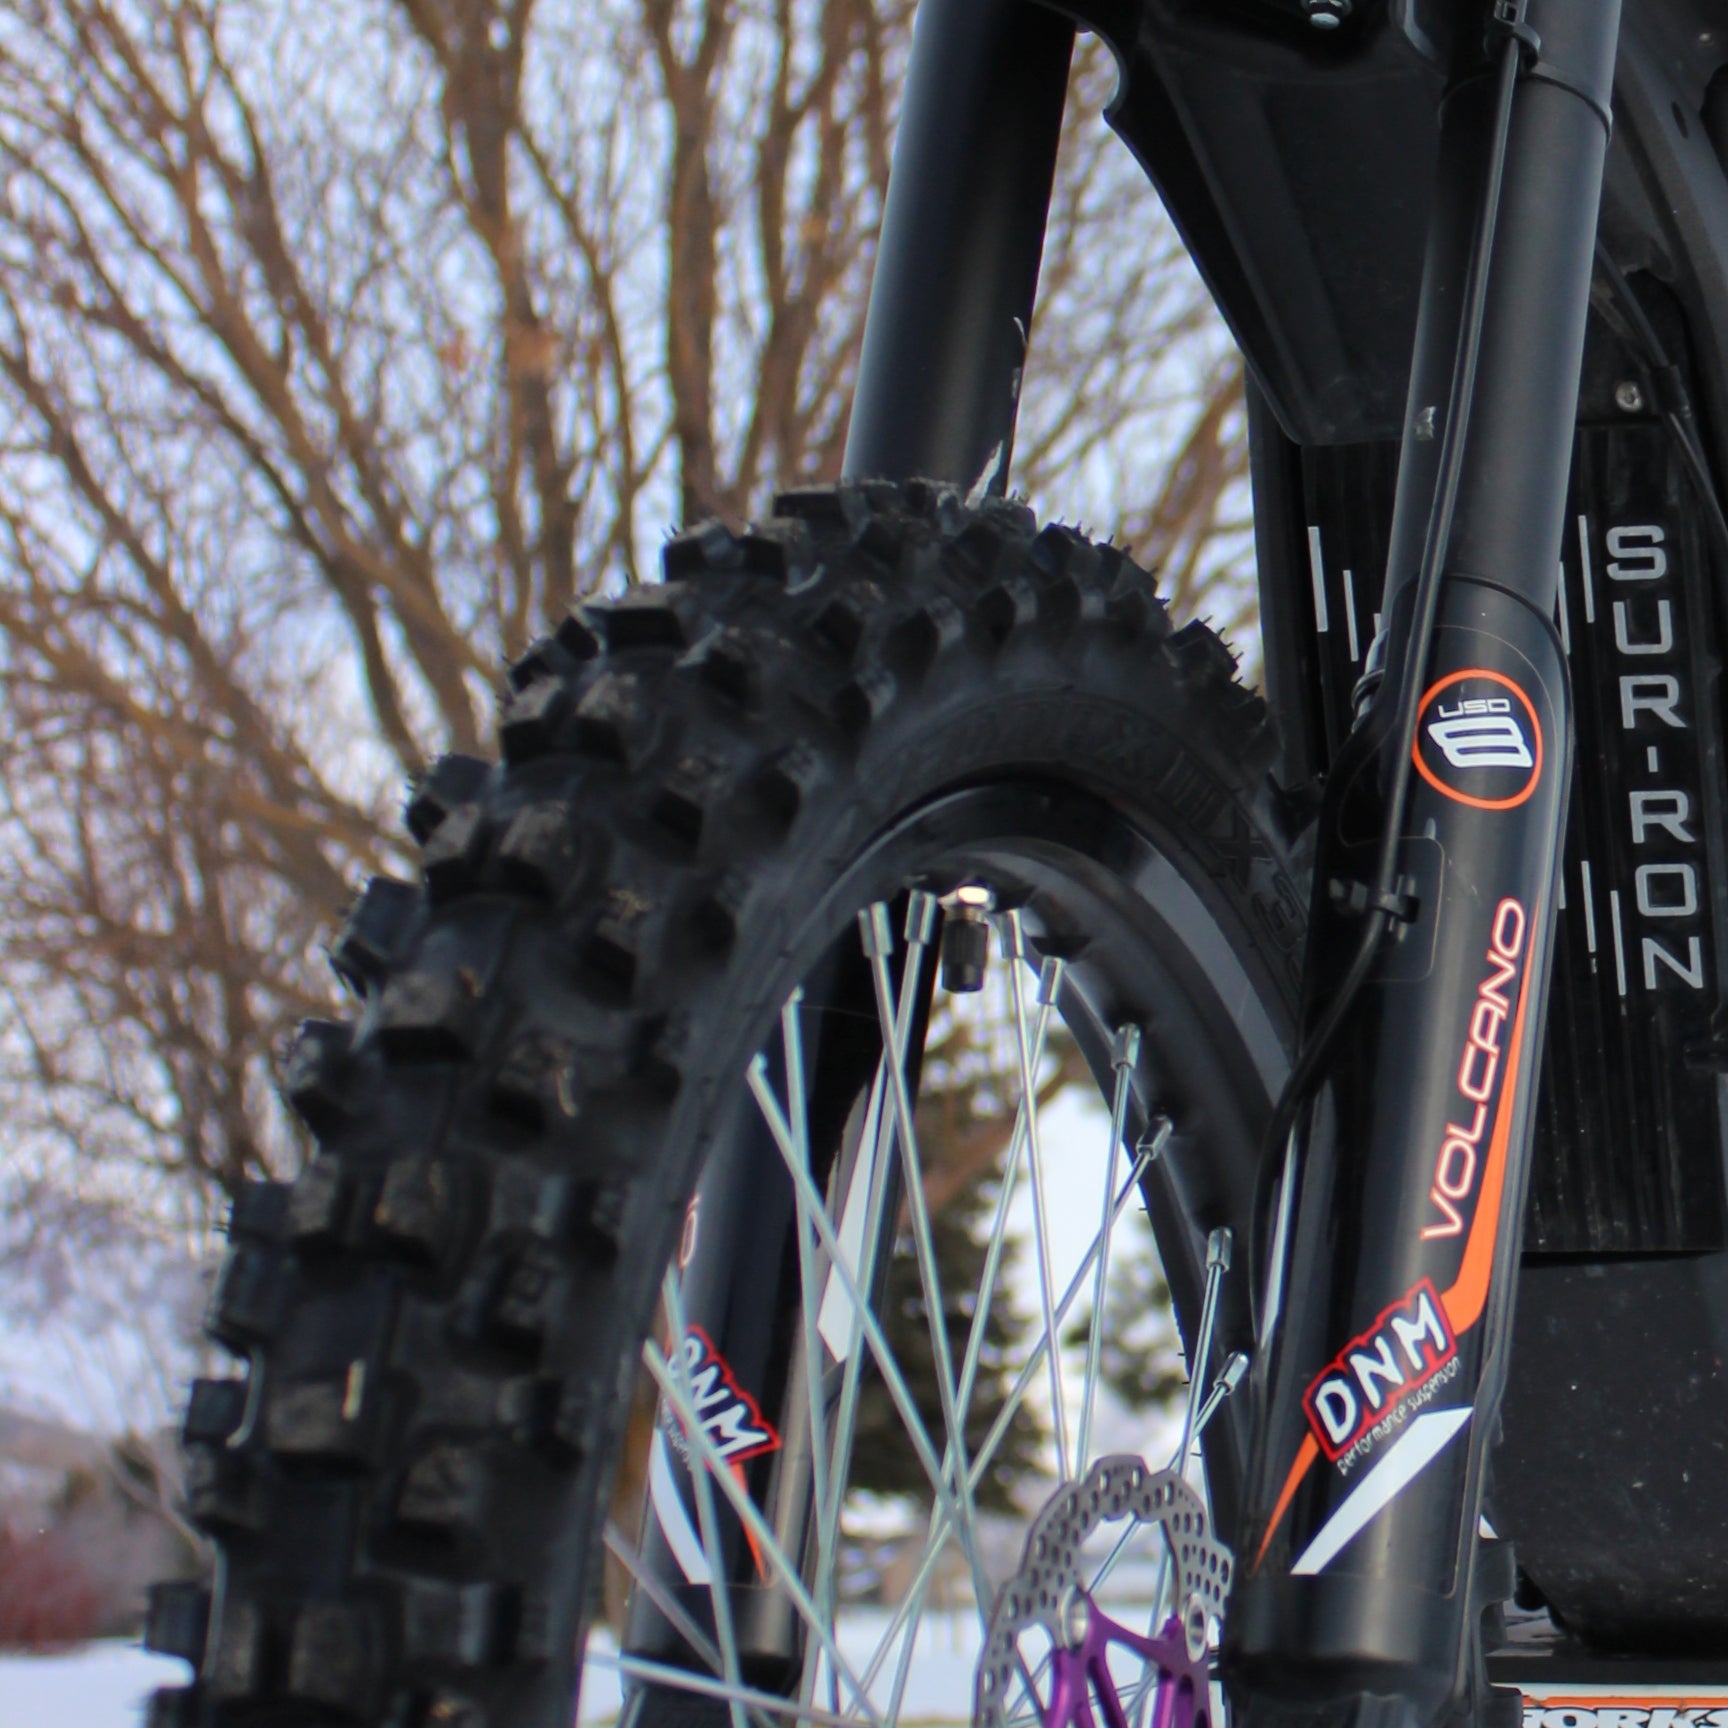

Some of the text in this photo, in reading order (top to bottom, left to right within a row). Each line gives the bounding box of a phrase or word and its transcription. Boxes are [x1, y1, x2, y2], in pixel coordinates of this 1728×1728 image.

[1438, 698, 1511, 718] USD
[1422, 898, 1525, 1240] VOLCANO
[1316, 1292, 1450, 1448] DNM
[1335, 1356, 1462, 1476] performance suspension
